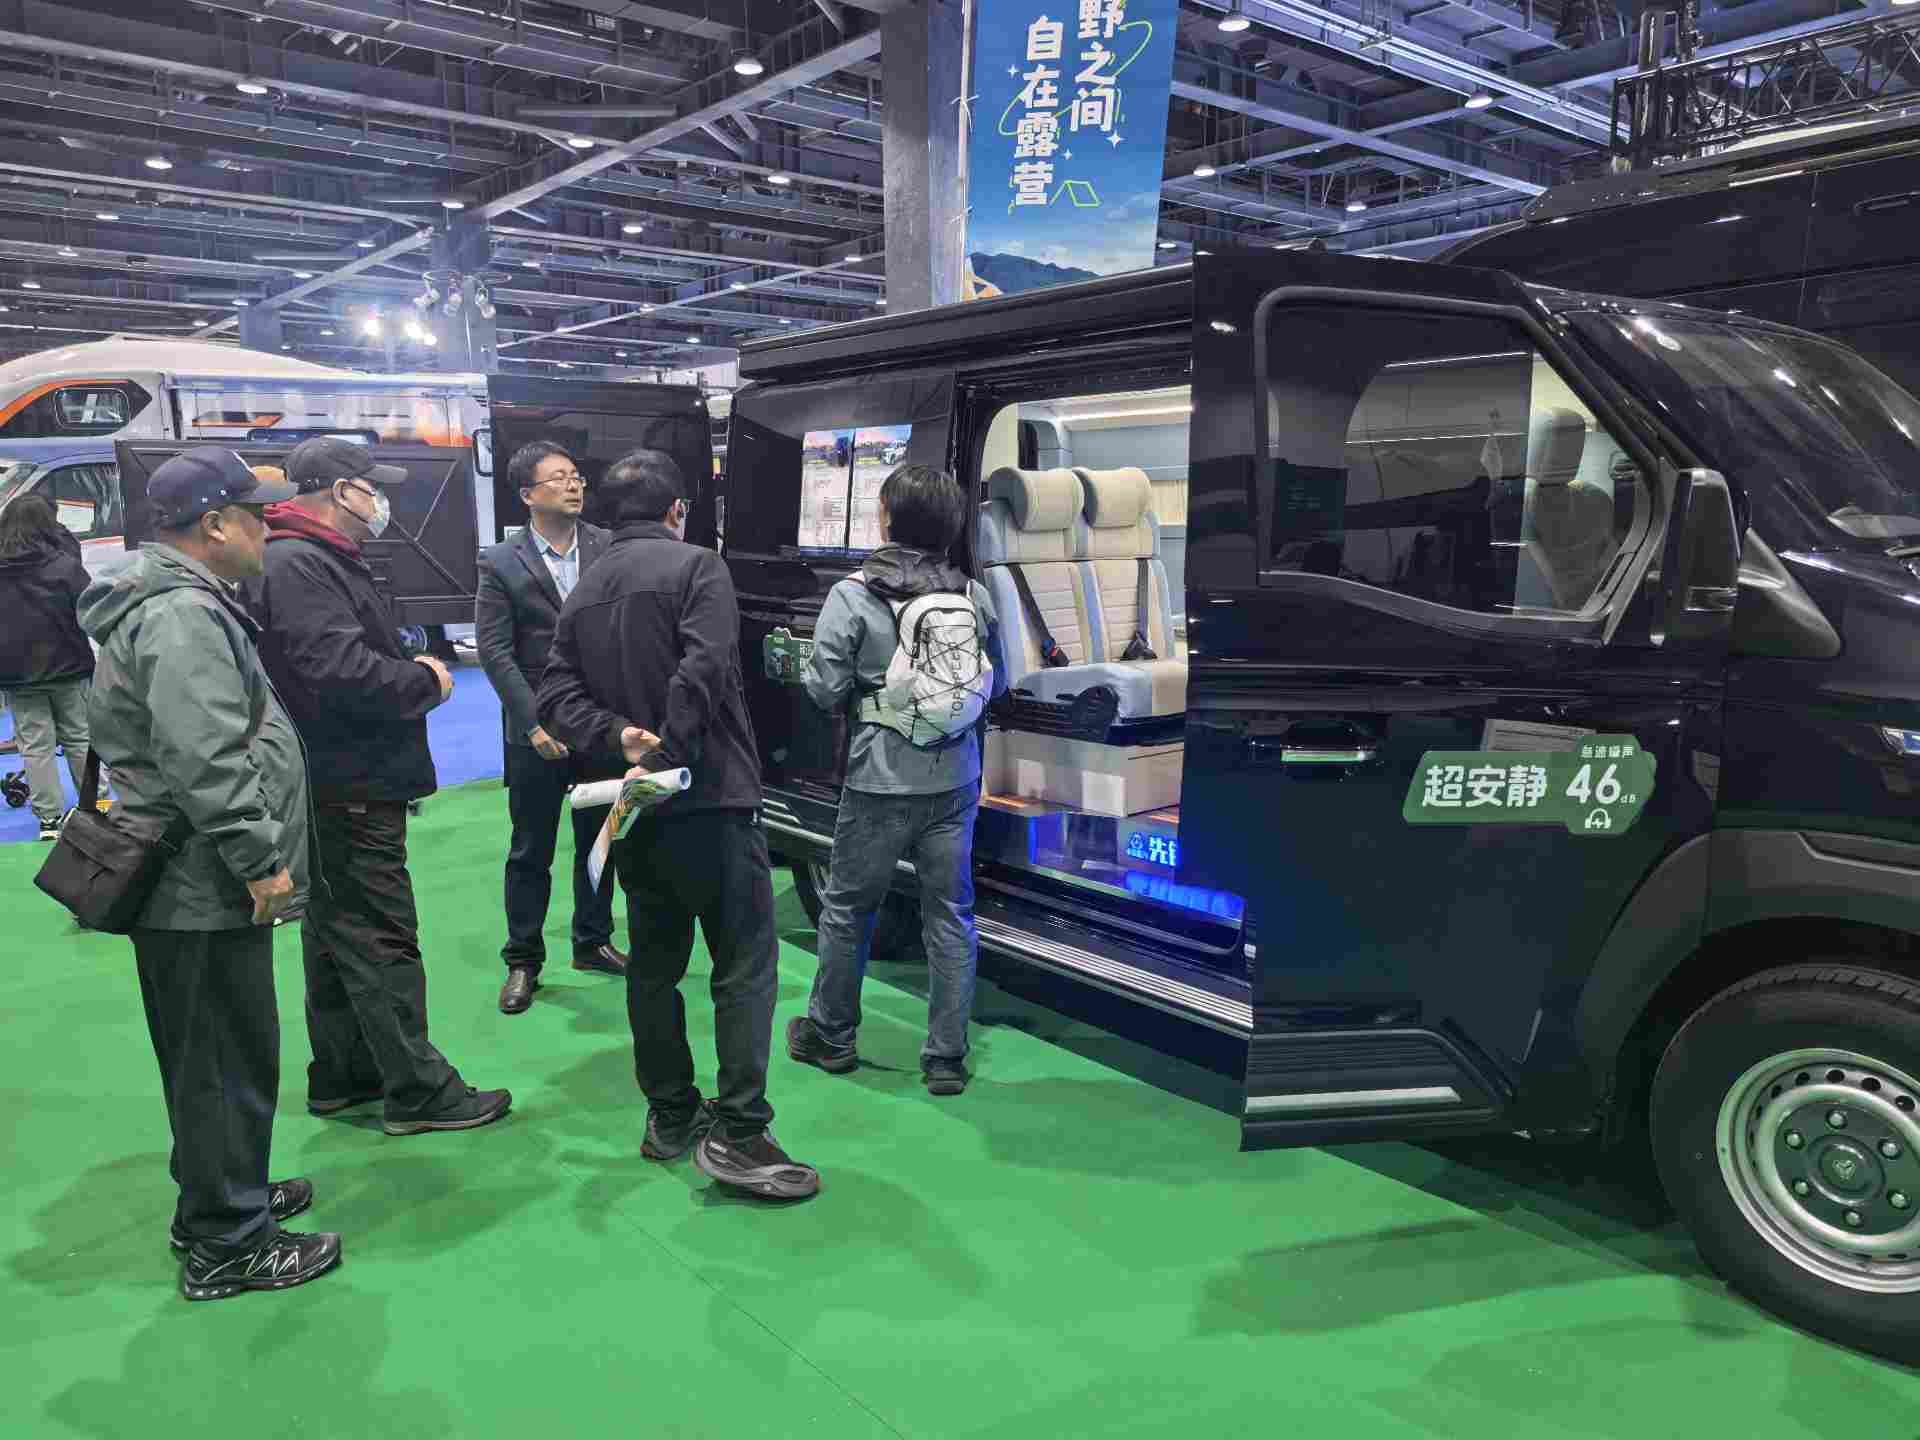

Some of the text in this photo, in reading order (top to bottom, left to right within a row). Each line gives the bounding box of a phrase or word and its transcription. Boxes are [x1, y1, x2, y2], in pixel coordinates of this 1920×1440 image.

[1013, 15, 1064, 206] 自在露营
[1069, 0, 1124, 132] 野之间
[1421, 764, 1548, 808] 超安静
